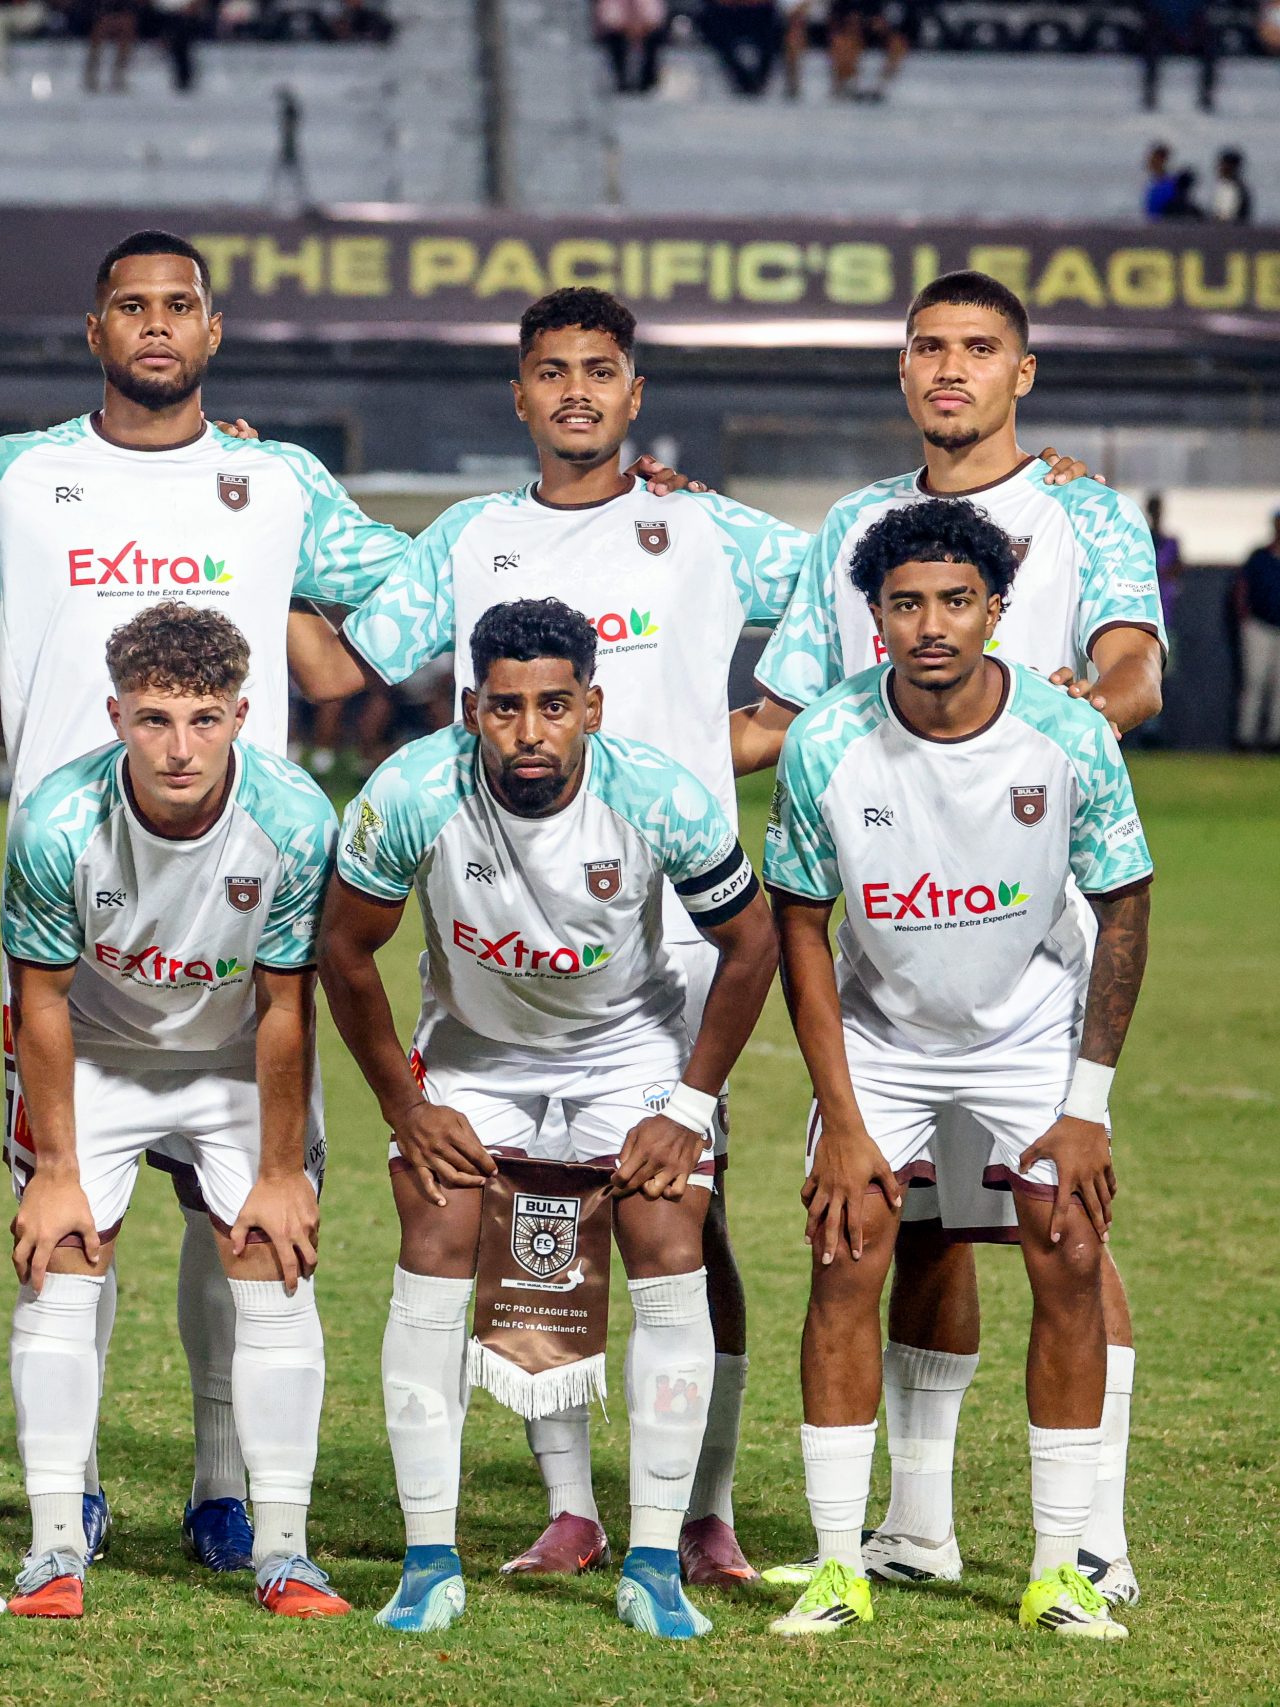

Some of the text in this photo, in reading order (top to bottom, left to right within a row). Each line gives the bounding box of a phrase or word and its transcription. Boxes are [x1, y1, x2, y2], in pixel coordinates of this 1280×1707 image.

[200, 234, 393, 296] THE
[408, 236, 893, 303] PACIFIC'S
[68, 541, 200, 586] Extra
[185, 588, 230, 598] Experience
[615, 642, 658, 654] Experience
[863, 873, 996, 920] Extra
[894, 924, 932, 932] Welcome
[959, 919, 981, 927] Extra
[982, 909, 1028, 924] Experience
[453, 919, 580, 974] Extra
[95, 943, 214, 983] Extra
[526, 1200, 568, 1215] BULA
[537, 1238, 552, 1247] FC
[494, 1303, 588, 1318] OFC PRO LEAGUE 2026
[491, 1319, 511, 1328] Bula
[512, 1321, 524, 1329] FC
[536, 1323, 575, 1333] Auckland
